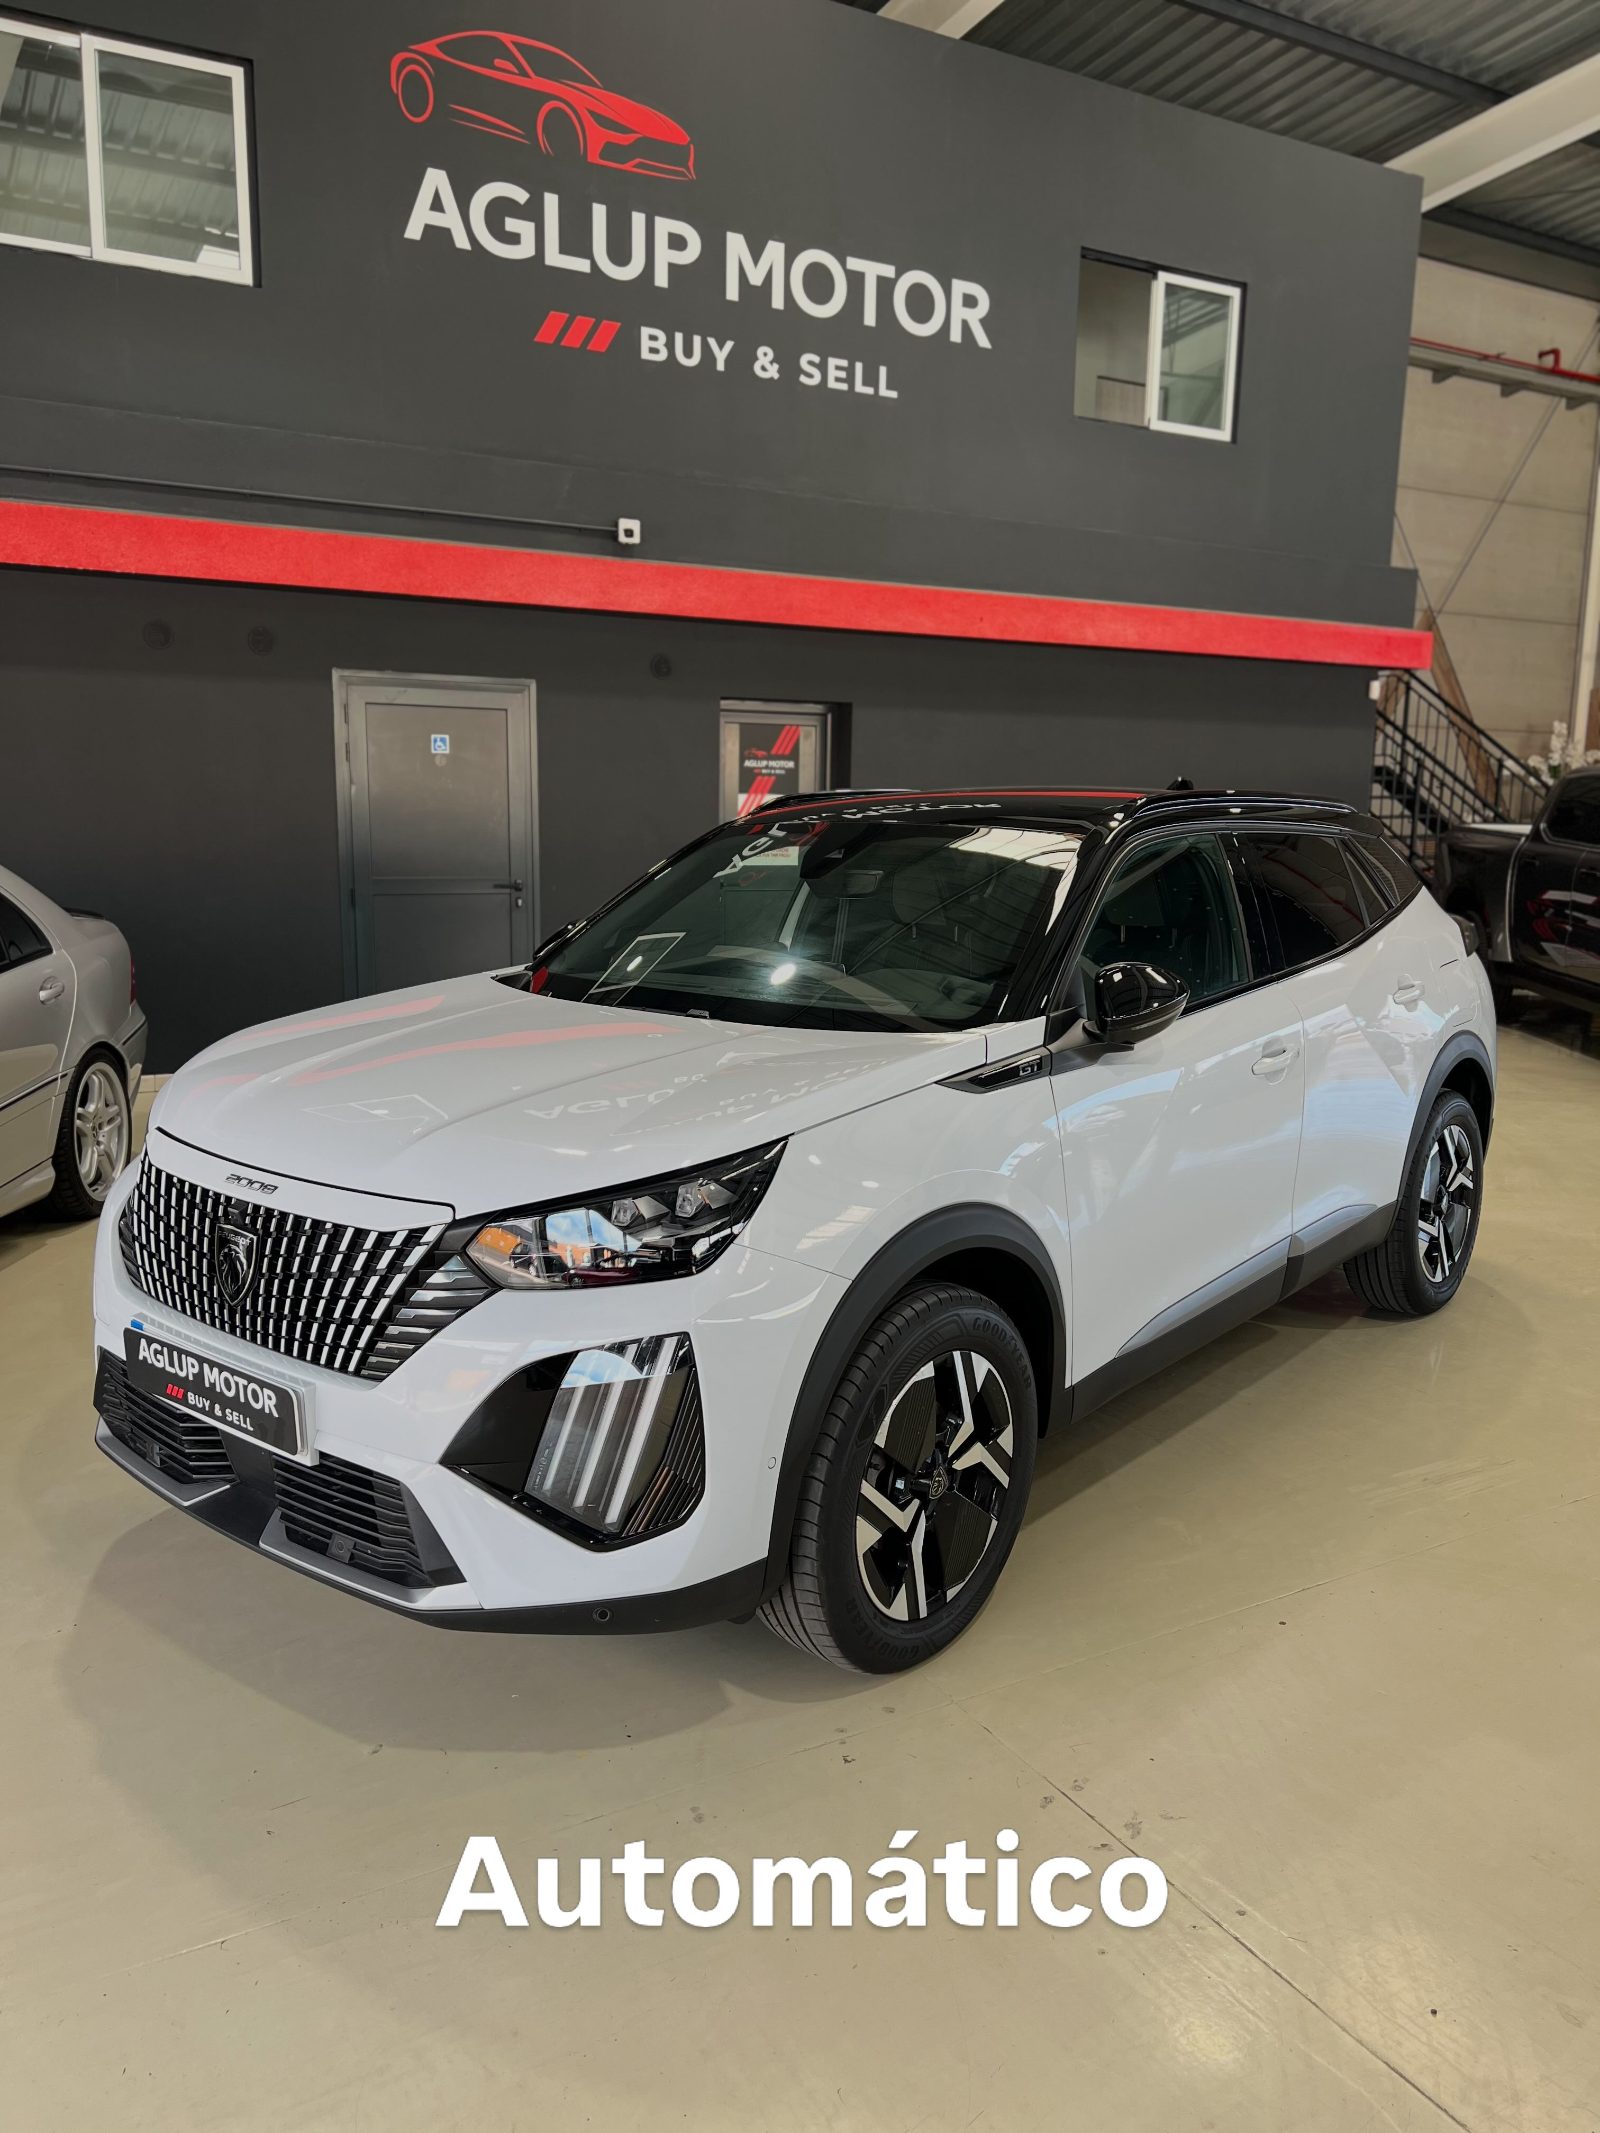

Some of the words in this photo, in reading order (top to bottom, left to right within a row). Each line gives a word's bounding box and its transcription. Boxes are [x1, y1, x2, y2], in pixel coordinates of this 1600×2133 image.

[404, 167, 702, 289] AGLUP
[725, 231, 992, 350] MOTOR
[640, 325, 735, 372] BUY
[753, 345, 780, 380] &
[798, 352, 899, 399] SELL
[768, 760, 795, 769] MOTOR
[1019, 1059, 1041, 1077] GT
[225, 1173, 279, 1195] 2008
[138, 1338, 200, 1381] AGLUP
[203, 1363, 279, 1418] MOTOR
[972, 1316, 1032, 1390] GOODYEAR
[187, 1391, 211, 1412] BUY
[214, 1403, 223, 1417] &
[225, 1408, 254, 1431] SELL
